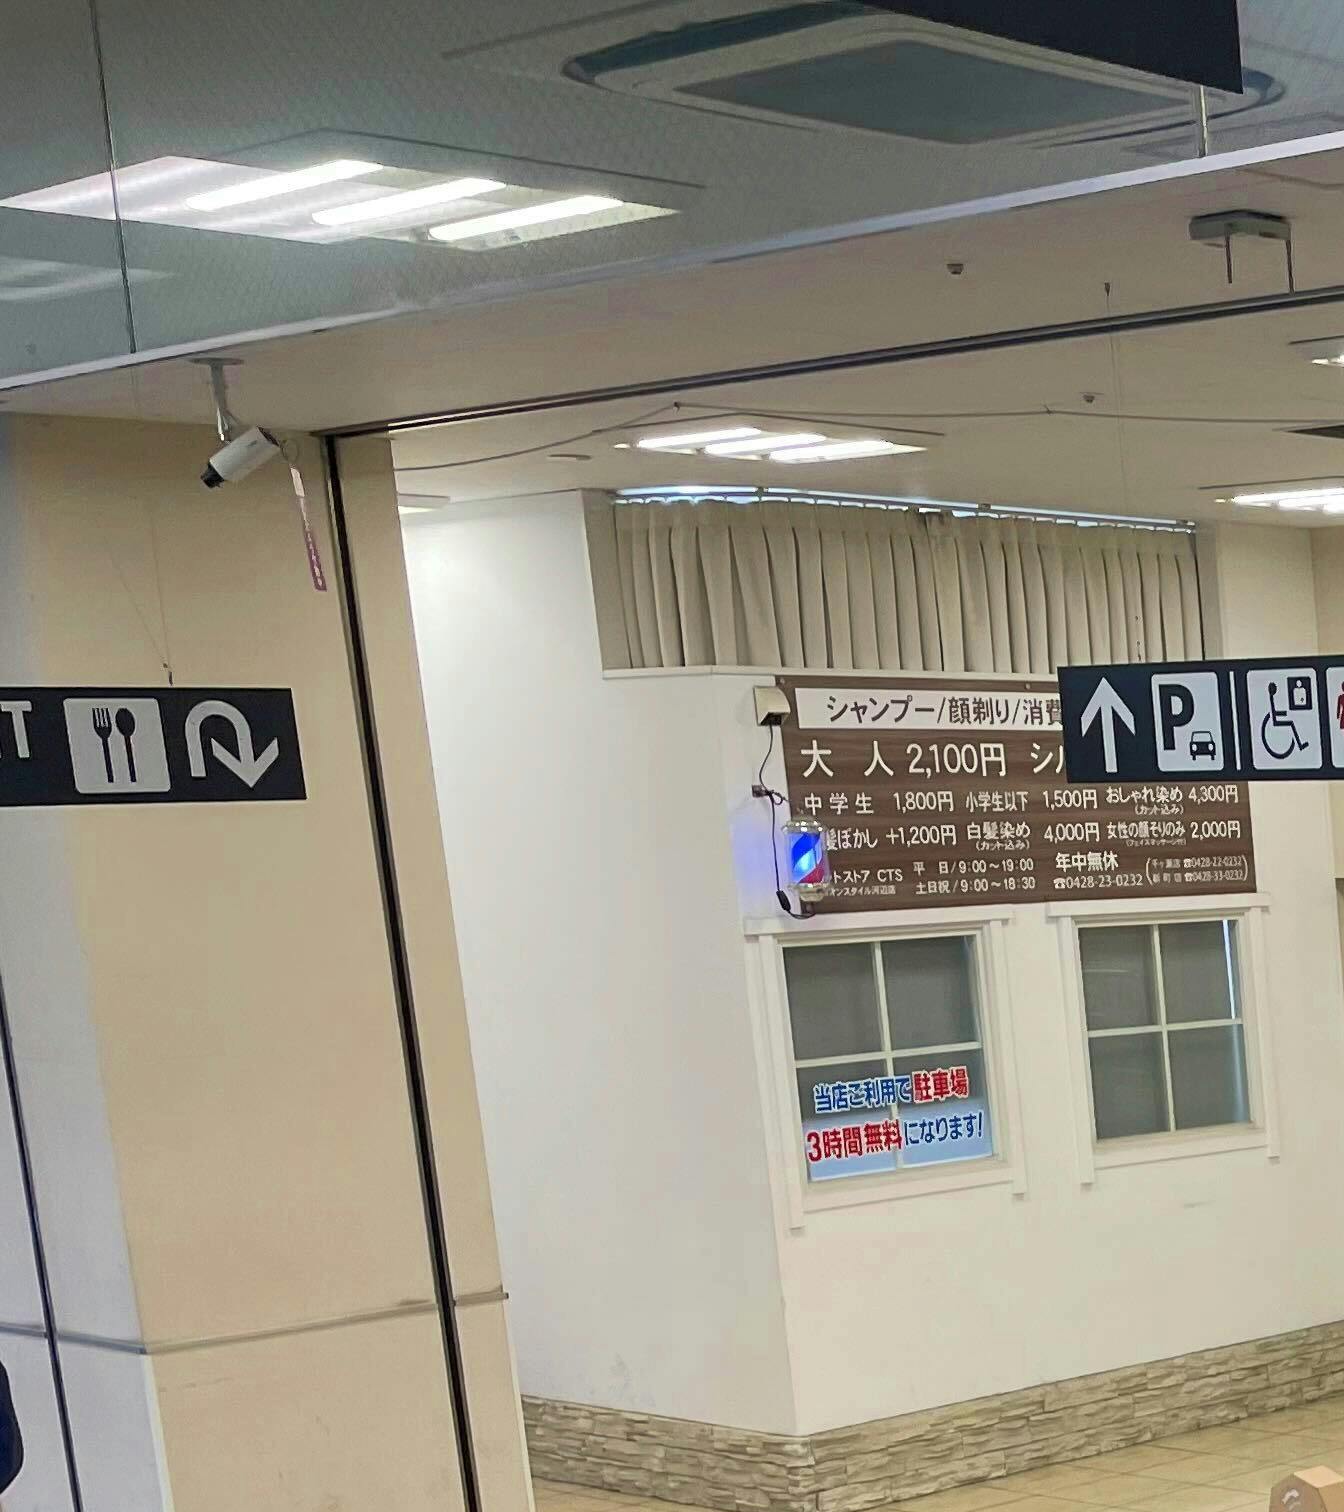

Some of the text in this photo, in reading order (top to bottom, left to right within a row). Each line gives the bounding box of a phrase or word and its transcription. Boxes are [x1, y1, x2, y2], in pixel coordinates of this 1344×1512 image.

[0, 700, 32, 758] T
[1159, 684, 1194, 750] P
[906, 743, 1006, 779] 2,100円
[893, 791, 954, 814] 1,800円
[965, 790, 1029, 813] 小学生以下
[1042, 789, 1098, 811] 1,500円
[1105, 786, 1183, 804] おしゃれ染め
[1188, 784, 1239, 804] 4,300円
[826, 828, 878, 850] 髪ぼかし
[885, 825, 957, 847] +1,200円
[966, 821, 1031, 840] 白髪染め
[1043, 822, 1100, 844] 4,000円
[1190, 819, 1241, 840] 2,000円
[832, 868, 903, 884] トストア CTS
[1055, 851, 1119, 872] 年中無休
[815, 1067, 968, 1112] 当店ご利用で駐車場
